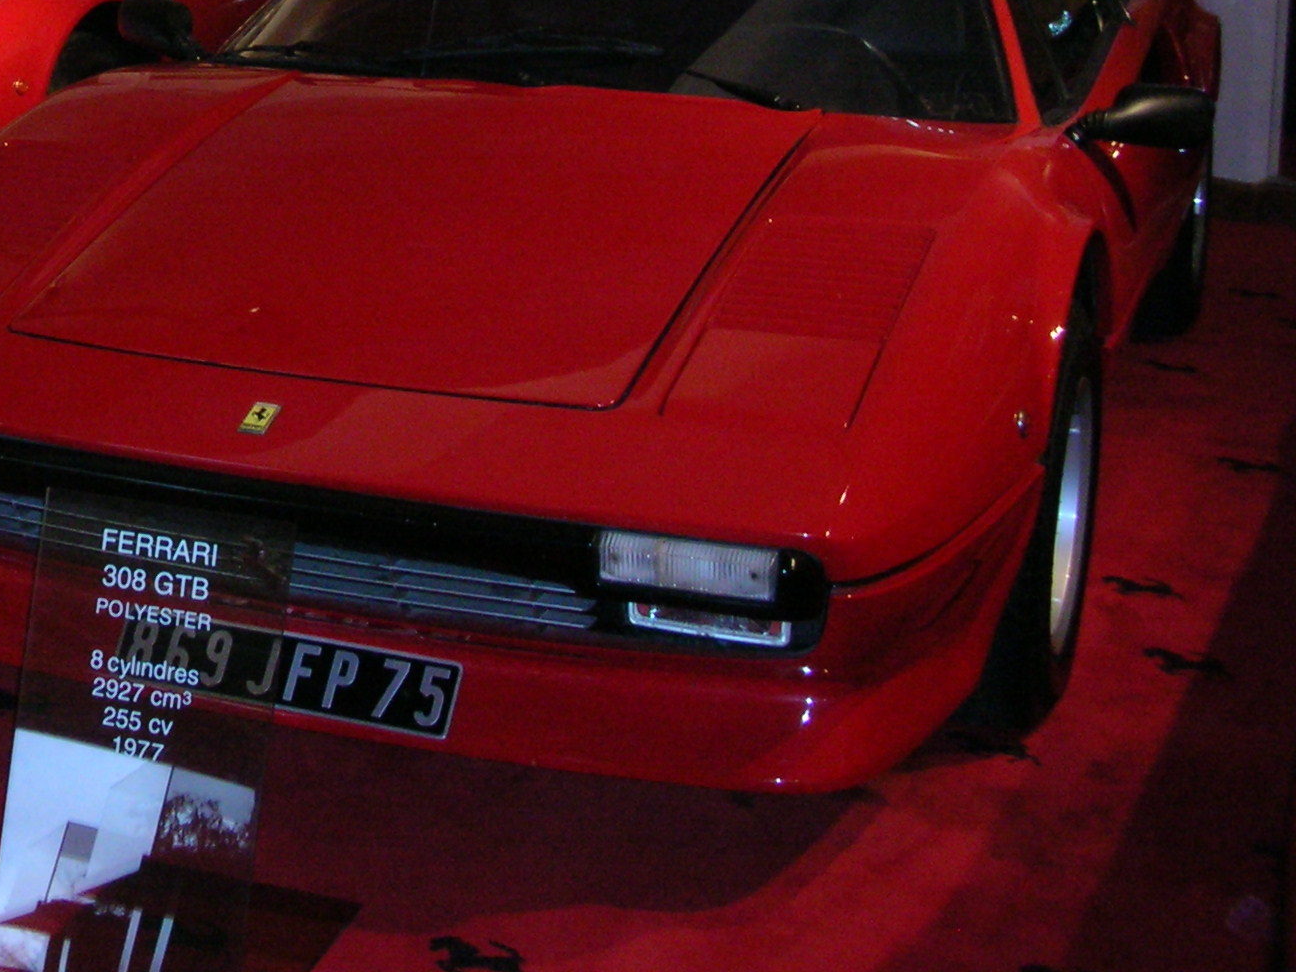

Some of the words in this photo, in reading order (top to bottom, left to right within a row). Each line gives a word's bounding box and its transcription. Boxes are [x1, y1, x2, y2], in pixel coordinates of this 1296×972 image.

[102, 528, 218, 568] FERRARI
[102, 564, 147, 591] 308
[154, 571, 209, 601] GTB
[95, 597, 212, 631] POLYESTER
[90, 649, 104, 670] 8
[107, 655, 200, 686] cylindres
[246, 637, 360, 709] JFP
[371, 658, 452, 727] 75
[91, 677, 145, 703] 2927
[102, 706, 142, 731] 255
[148, 718, 174, 736] cv
[112, 735, 165, 762] 1977
